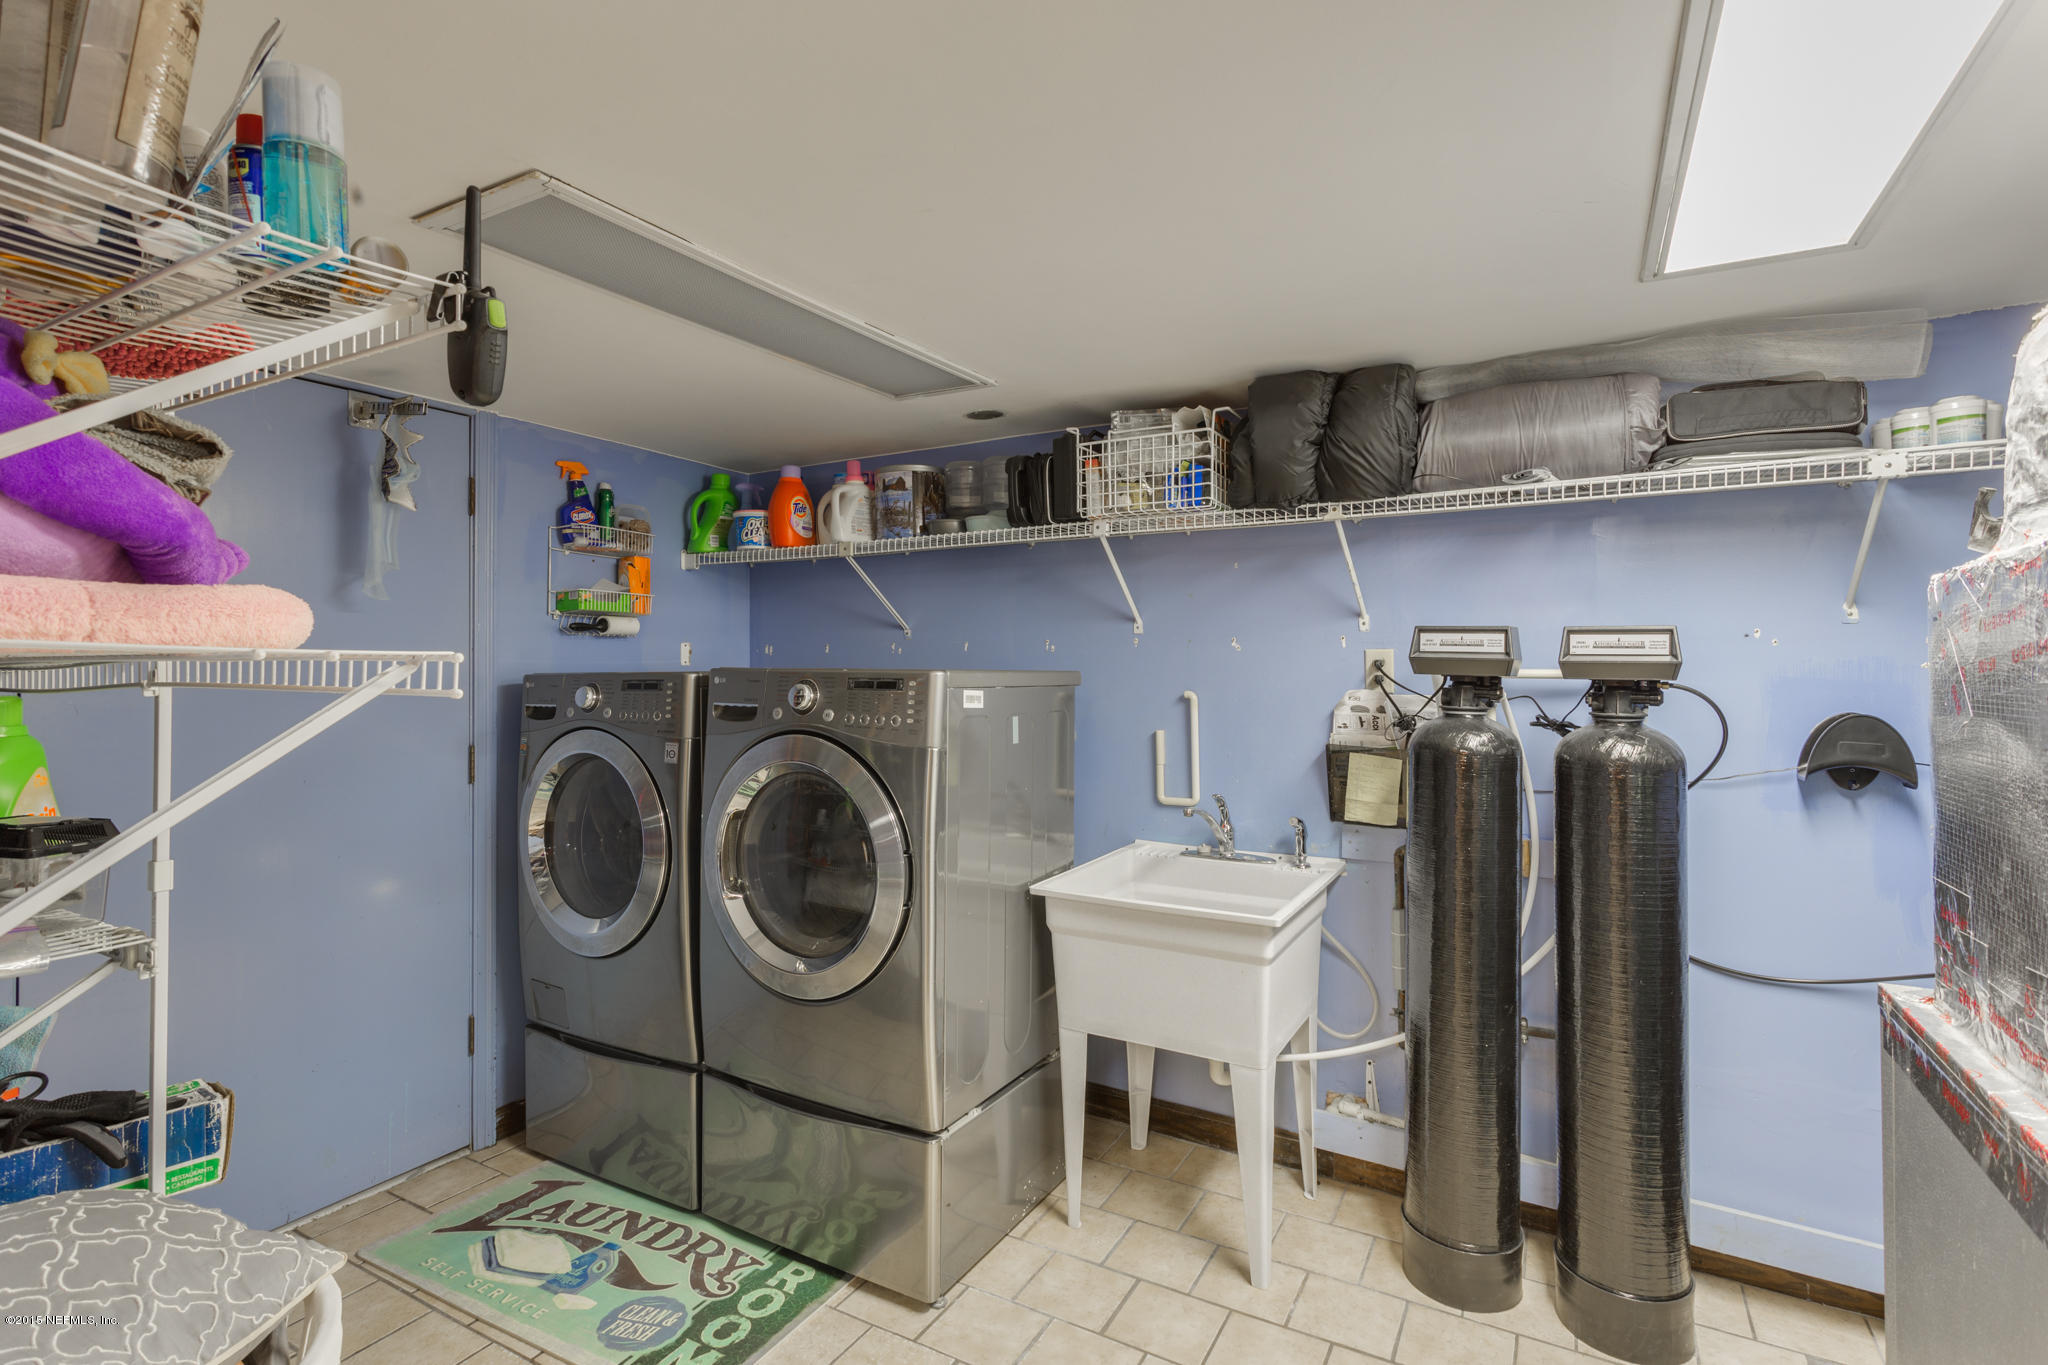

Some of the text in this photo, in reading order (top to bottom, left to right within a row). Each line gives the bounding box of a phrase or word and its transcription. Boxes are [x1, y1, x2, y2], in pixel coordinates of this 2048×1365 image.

[793, 503, 807, 515] Tide
[171, 1166, 214, 1182] RESTAURANTS
[171, 1175, 203, 1189] CATERING
[432, 1179, 766, 1299] LAUNDRY
[420, 1257, 550, 1320] SELF SERVICE
[617, 1304, 683, 1327] CLEAN &
[602, 1319, 662, 1342] FRESH
